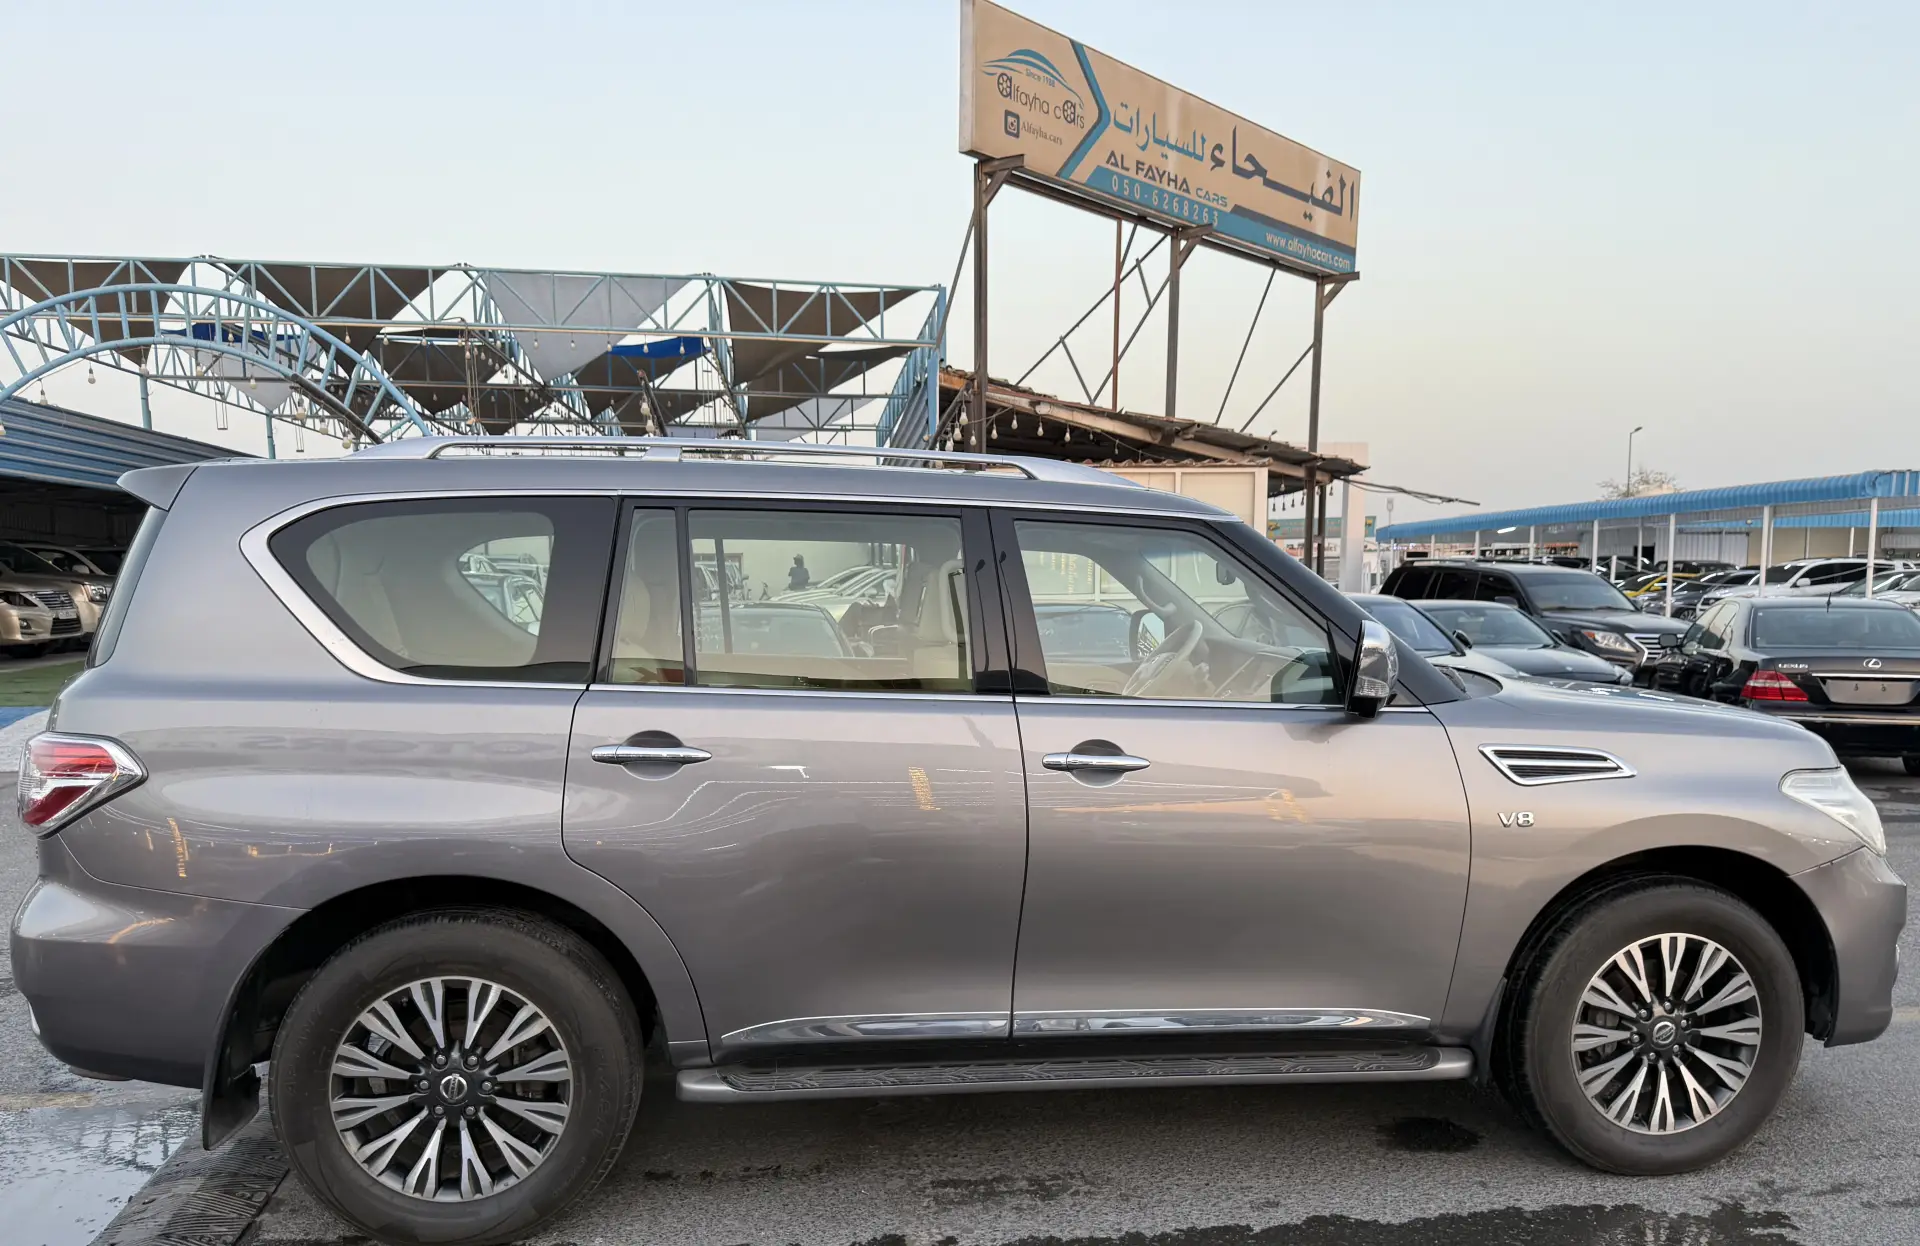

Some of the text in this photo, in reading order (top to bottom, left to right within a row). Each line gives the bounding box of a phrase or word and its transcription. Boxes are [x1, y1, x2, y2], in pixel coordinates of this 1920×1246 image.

[997, 72, 1085, 129] alfayha cars
[1020, 121, 1063, 146] Alfayha.cars
[1112, 101, 1207, 162] للسيارات
[1105, 150, 1228, 208] AL FAYHA CARS
[1265, 231, 1352, 271] www.alfayhacars.com
[1497, 811, 1535, 828] V8
